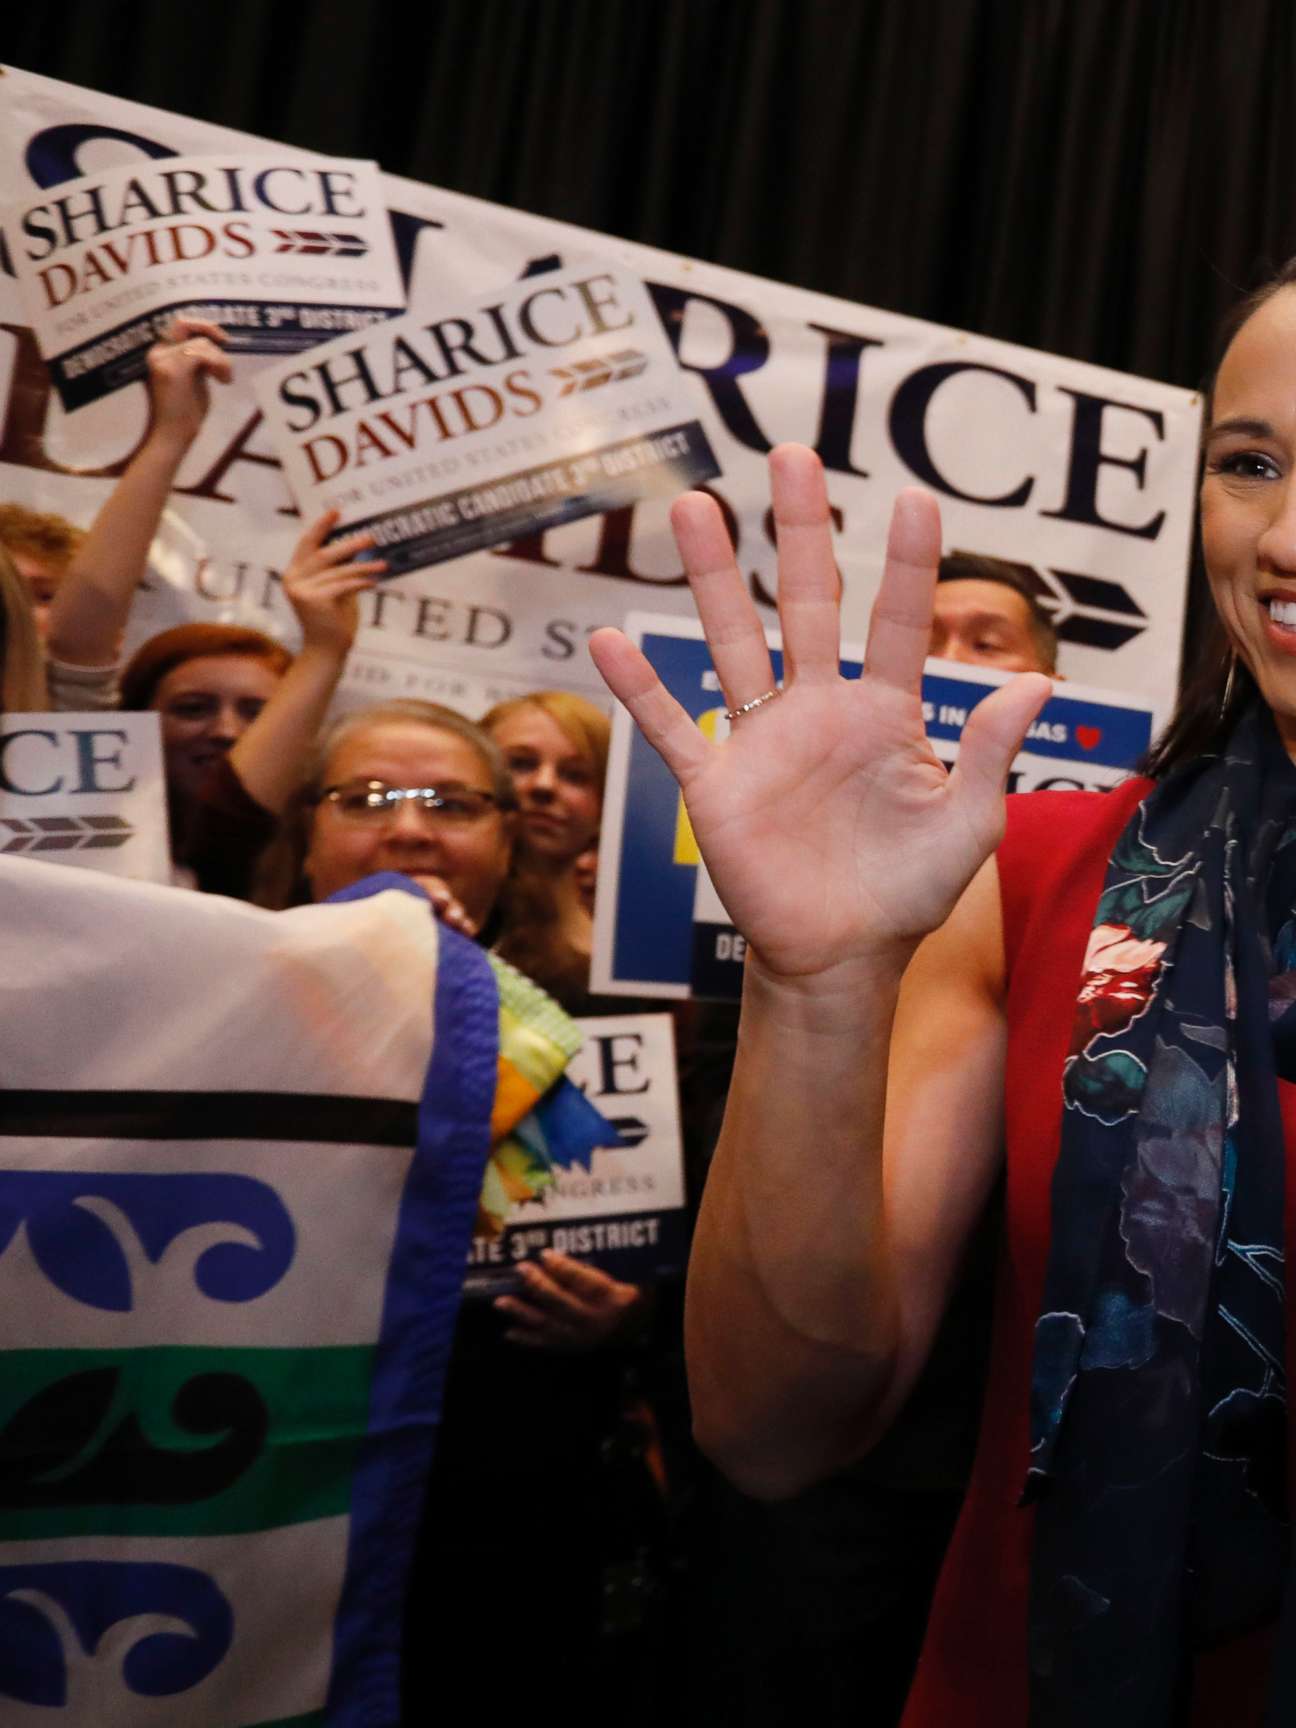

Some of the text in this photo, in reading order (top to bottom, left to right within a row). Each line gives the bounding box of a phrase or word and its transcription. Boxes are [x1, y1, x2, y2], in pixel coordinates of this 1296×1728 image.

[22, 168, 366, 261] SHARICE
[37, 221, 255, 309] DAVIDS
[279, 273, 634, 433] SHARICE
[302, 368, 543, 485] DAVIDS
[193, 552, 512, 651] UNTED
[940, 706, 964, 727] IN
[553, 1218, 660, 1254] DISTRICT
